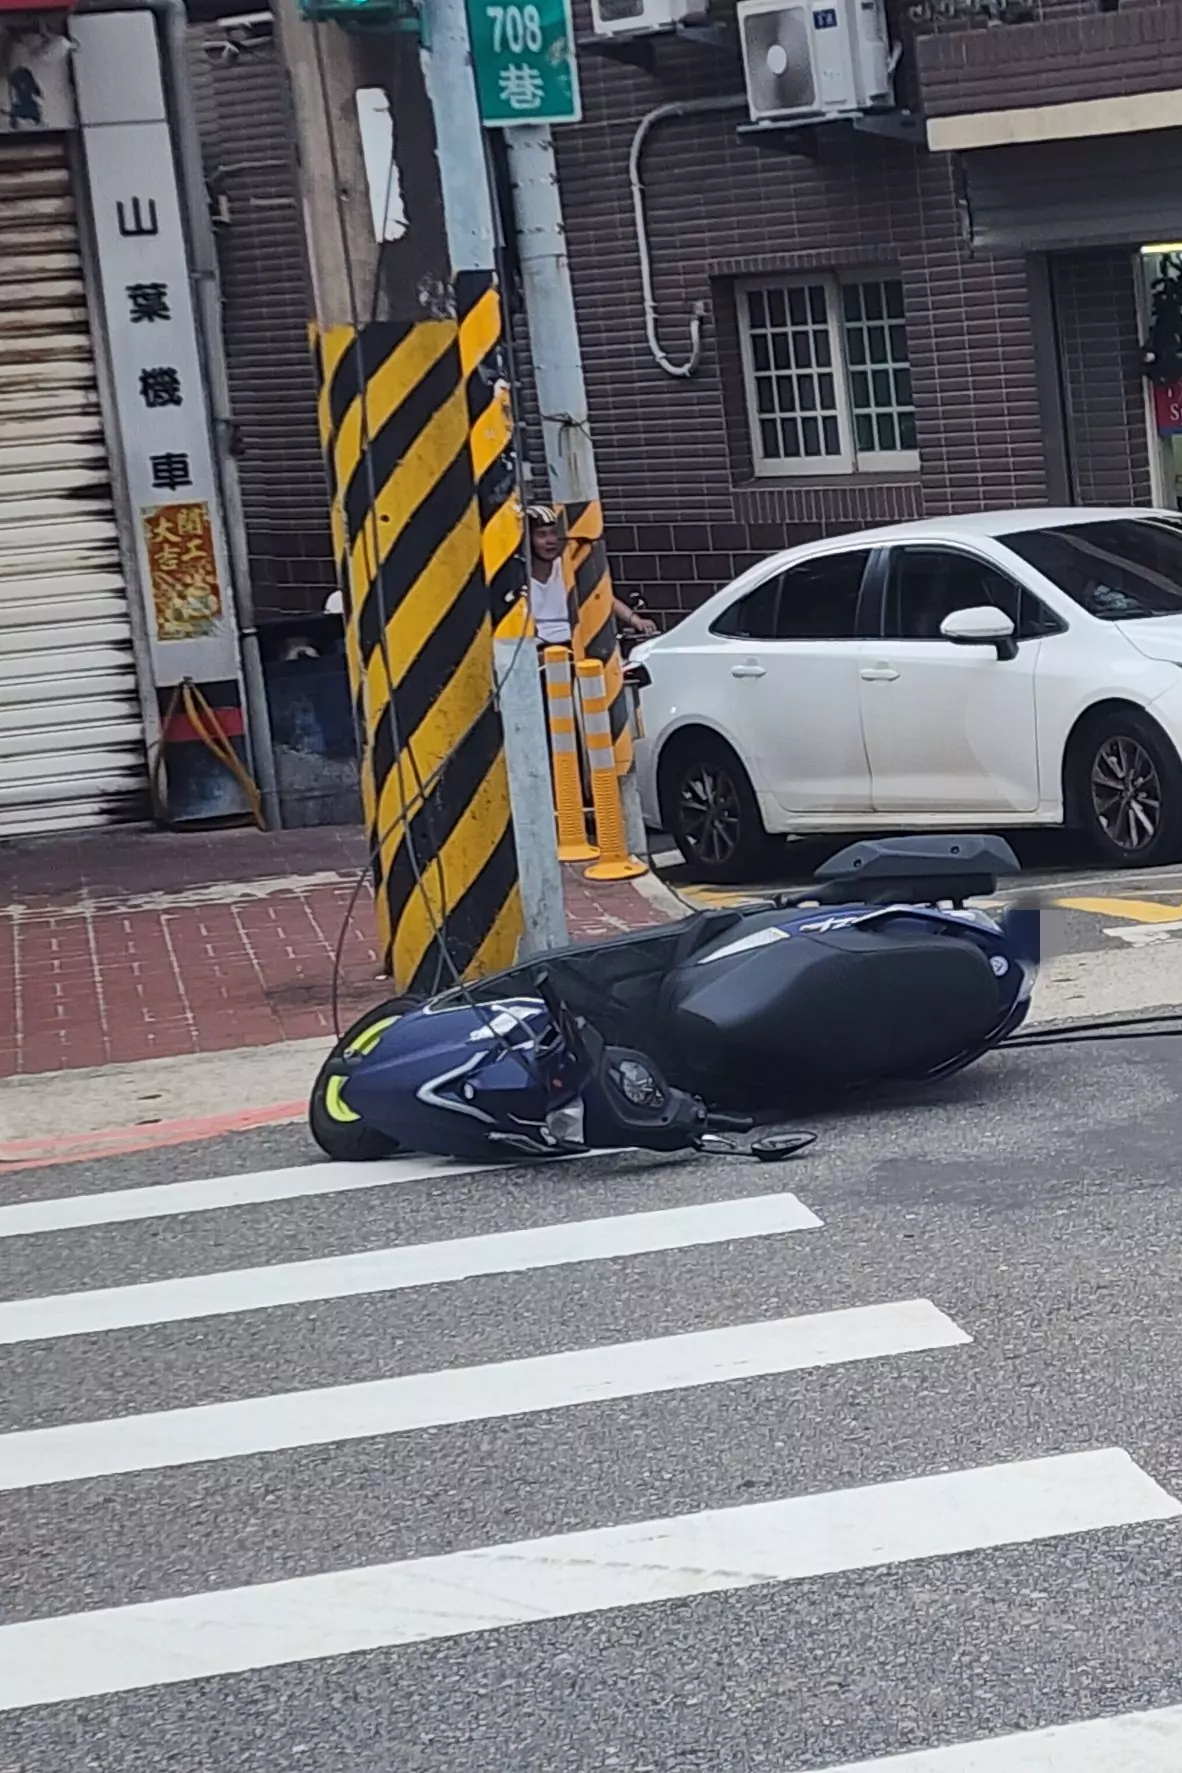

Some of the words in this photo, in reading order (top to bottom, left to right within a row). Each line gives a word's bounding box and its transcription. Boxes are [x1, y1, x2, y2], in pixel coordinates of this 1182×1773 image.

[485, 4, 542, 53] 708
[498, 62, 546, 110] 巷
[115, 196, 194, 491] 山葉機車
